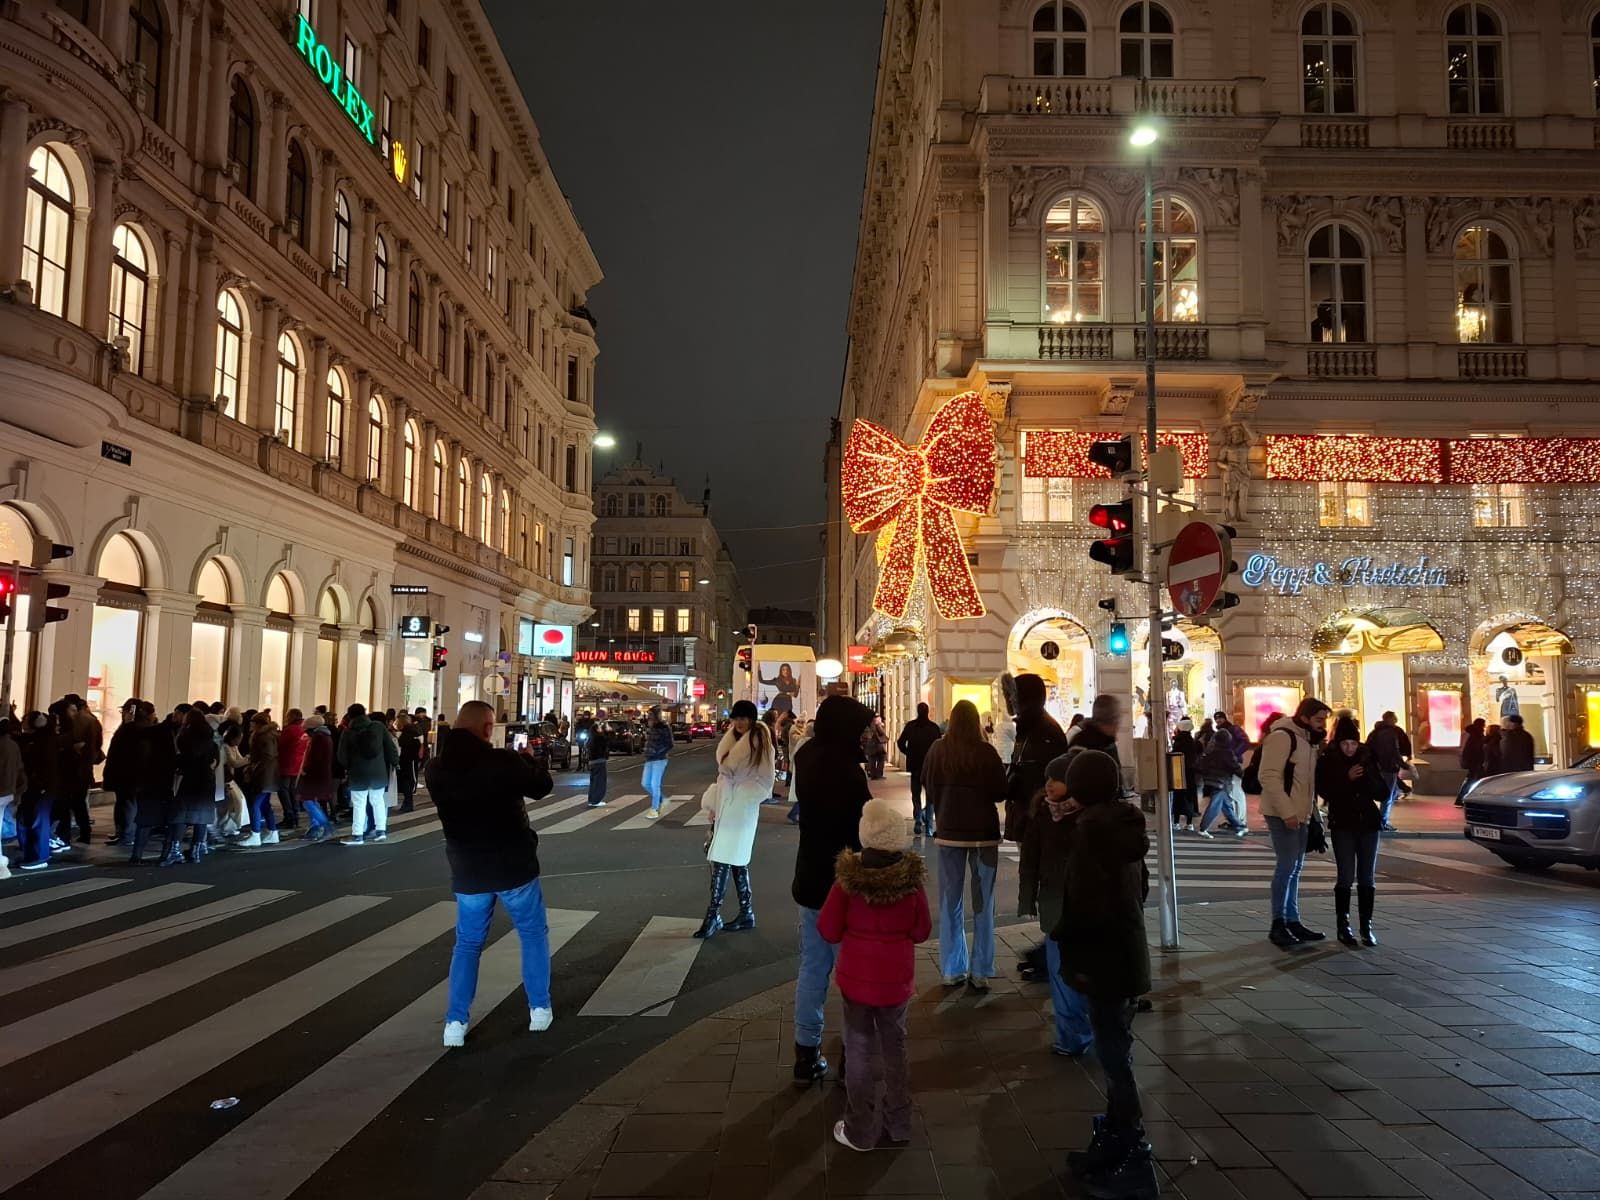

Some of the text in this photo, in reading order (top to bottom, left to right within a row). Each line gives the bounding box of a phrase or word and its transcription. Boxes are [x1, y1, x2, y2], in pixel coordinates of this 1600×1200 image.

[296, 13, 375, 145] ROLEX
[1314, 562, 1336, 585] &
[575, 651, 656, 662] OULIN ROUGE
